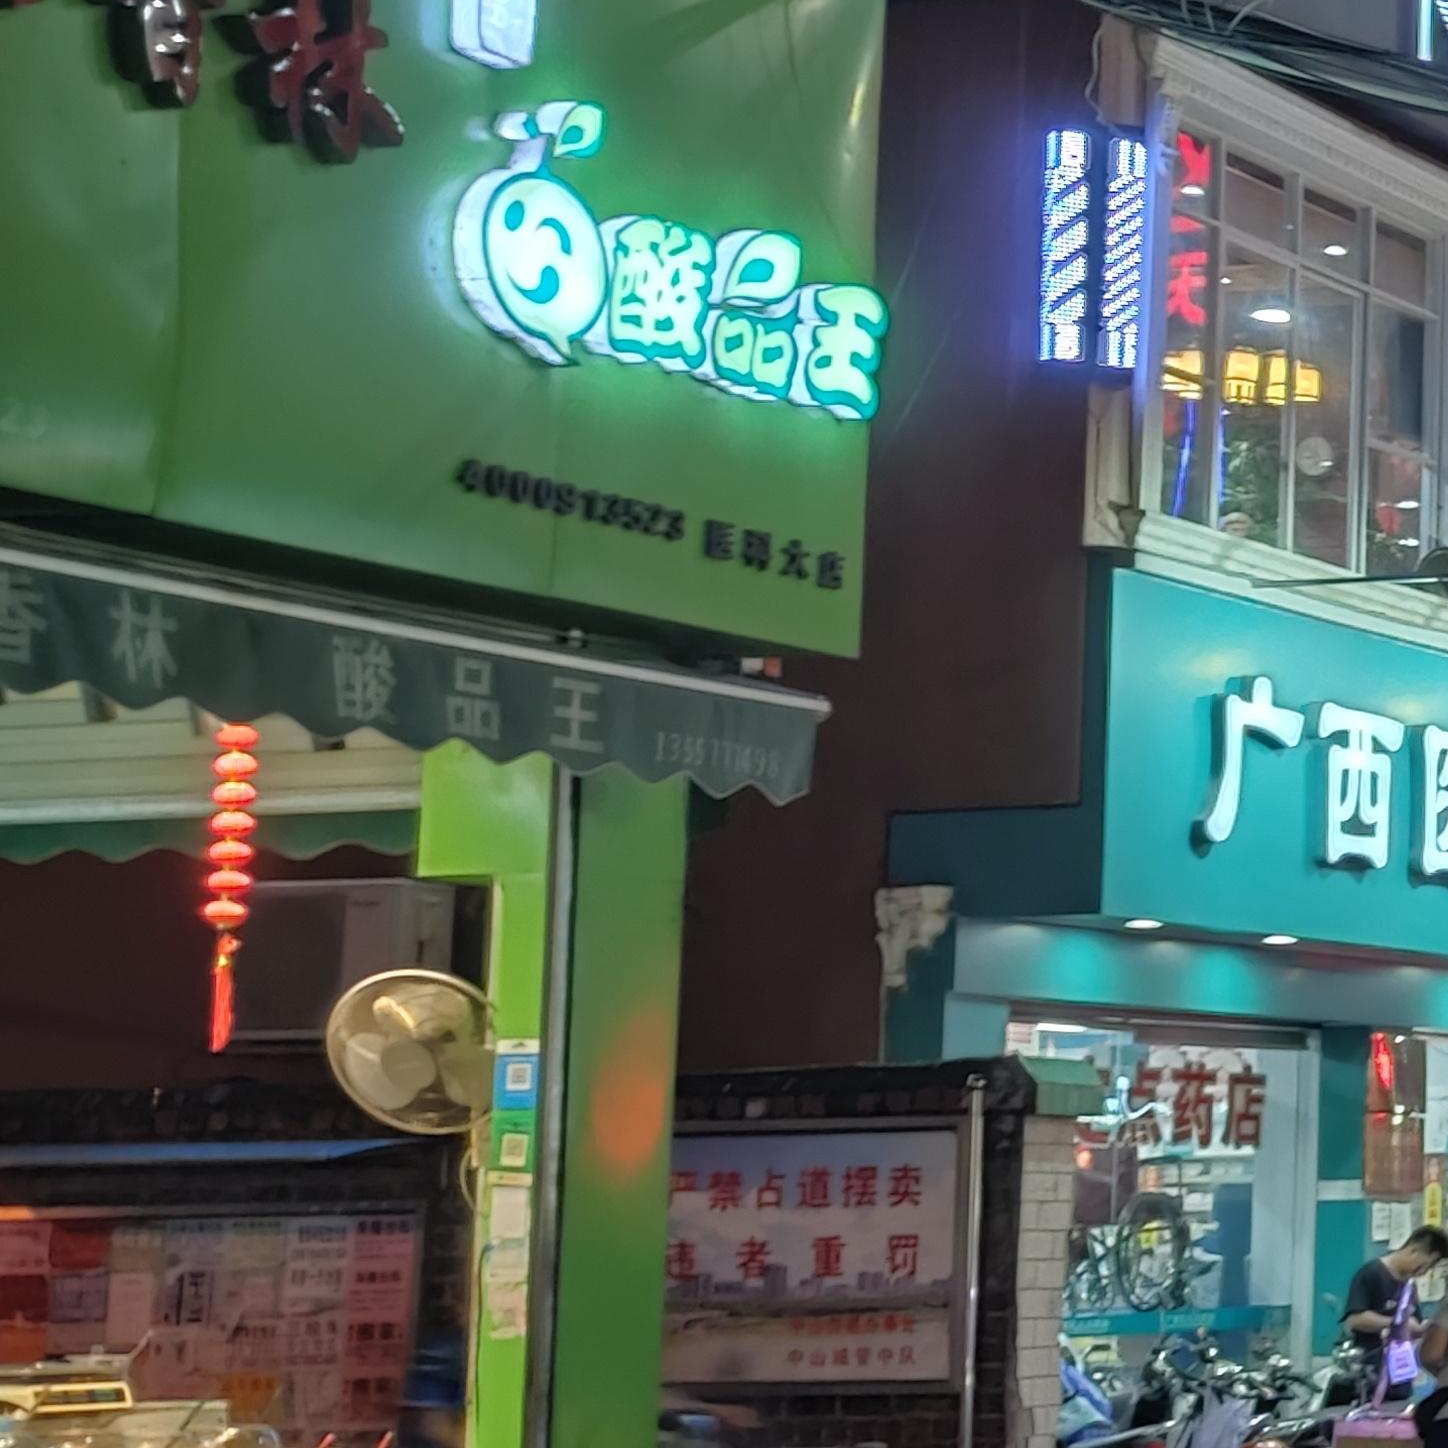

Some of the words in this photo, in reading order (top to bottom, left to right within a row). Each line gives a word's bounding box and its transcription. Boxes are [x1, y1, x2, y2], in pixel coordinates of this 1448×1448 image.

[603, 214, 889, 419] 酸品王
[668, 1163, 922, 1212] 严禁占道摆卖
